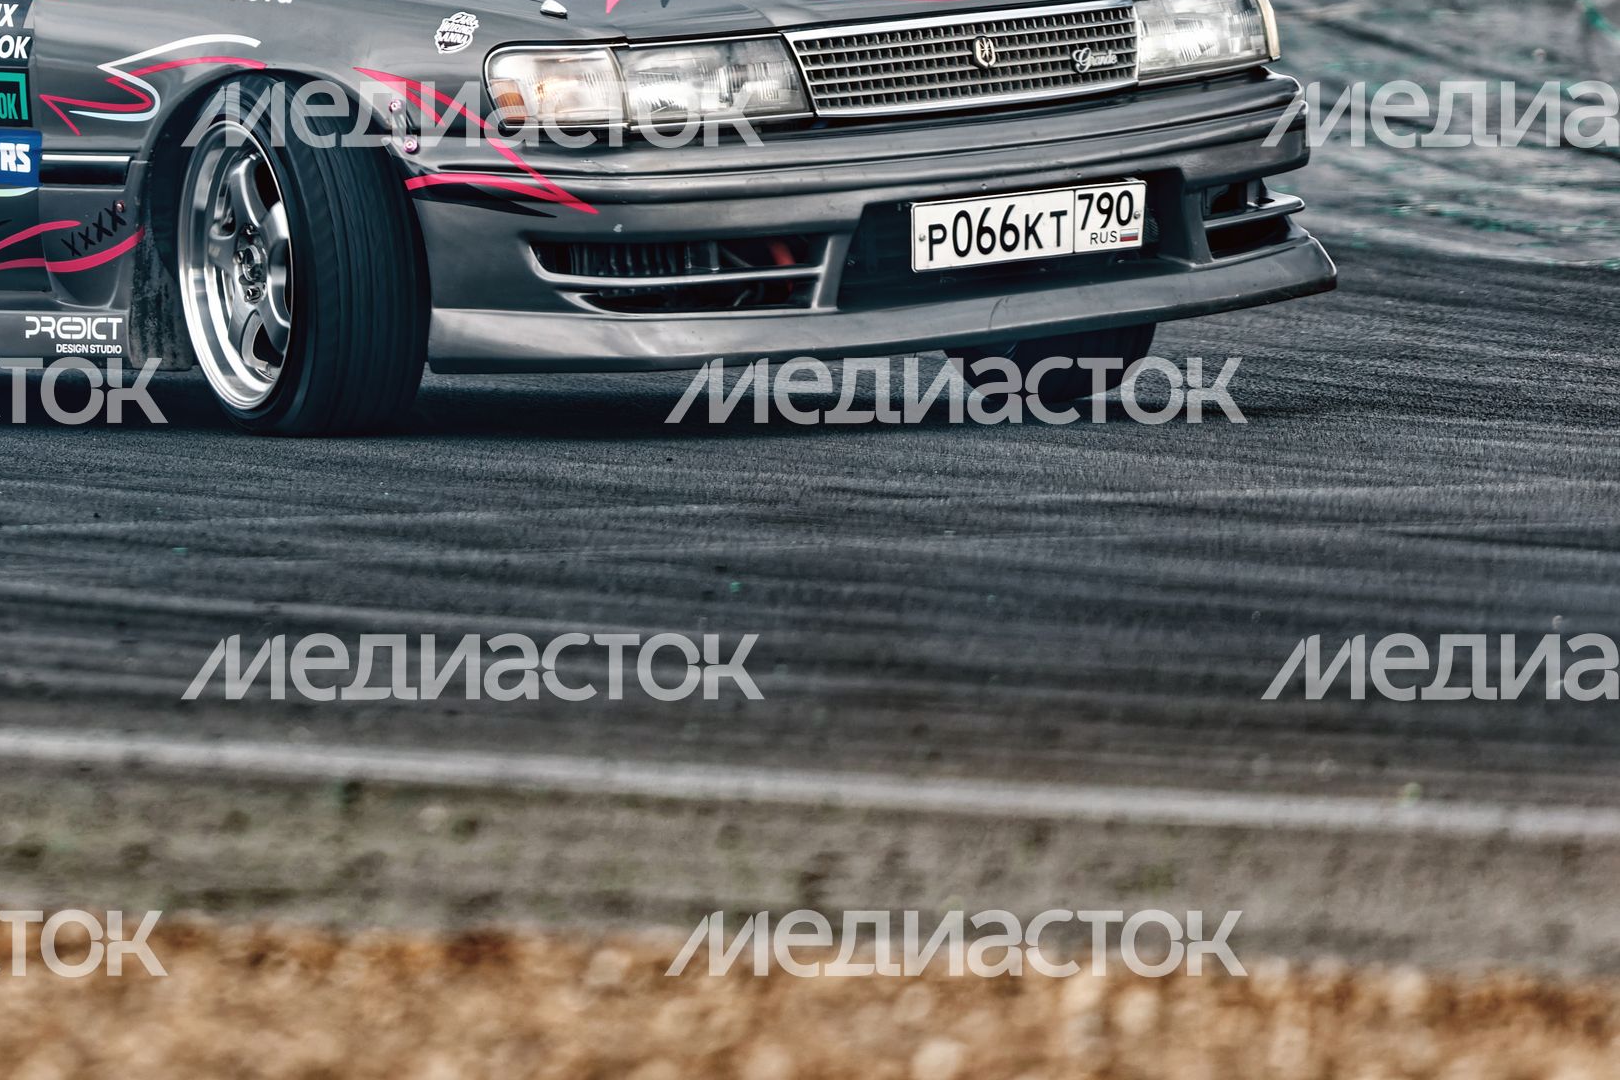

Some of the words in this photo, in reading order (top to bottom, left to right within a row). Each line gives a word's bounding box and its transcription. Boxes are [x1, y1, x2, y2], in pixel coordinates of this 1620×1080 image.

[1072, 47, 1118, 72] Grande
[1077, 190, 1134, 231] 790
[1089, 231, 1118, 245] RUS
[56, 343, 89, 354] DESIGN
[89, 344, 122, 354] STUDIO
